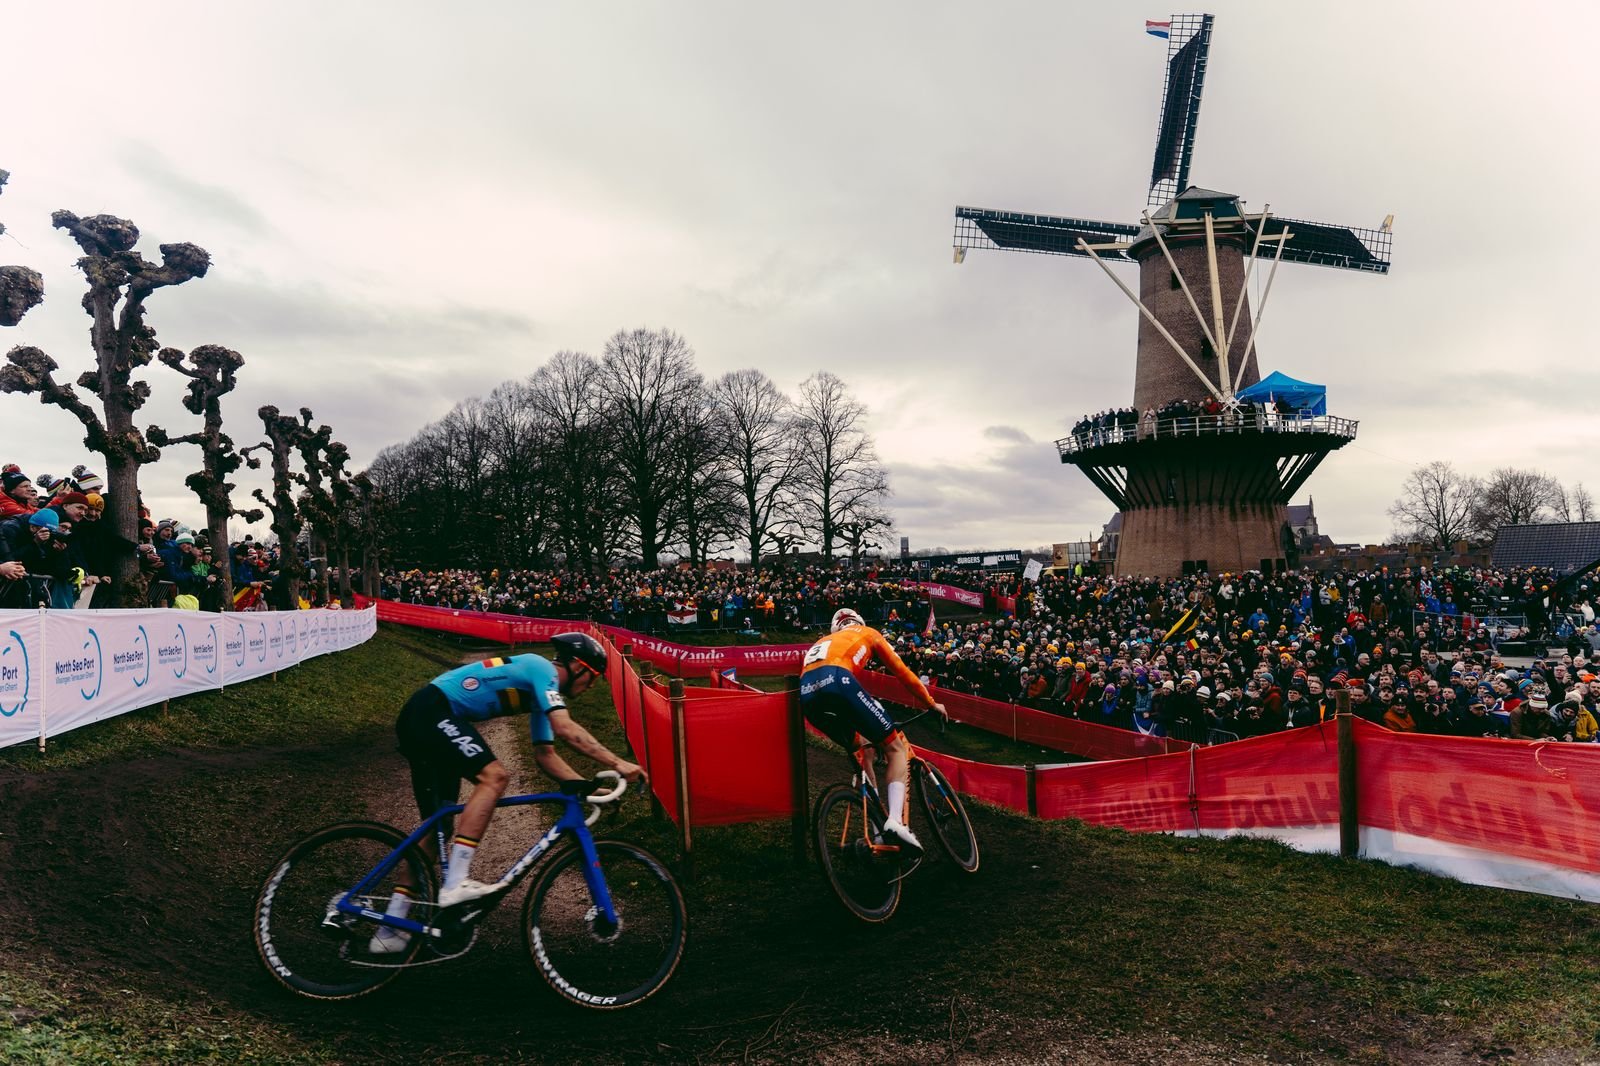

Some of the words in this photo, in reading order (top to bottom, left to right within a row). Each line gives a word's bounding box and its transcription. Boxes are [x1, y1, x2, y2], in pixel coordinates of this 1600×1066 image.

[957, 556, 980, 564] BURGERS
[1005, 553, 1020, 561] WALL
[113, 652, 126, 664] North
[126, 651, 135, 662] Sea
[135, 650, 143, 661] Port
[632, 638, 724, 663] waterzande
[809, 646, 821, 657] 3
[2, 666, 18, 680] Port
[55, 660, 71, 675] North
[72, 659, 82, 672] Sea
[83, 658, 94, 670] Port
[857, 690, 892, 731] Staatsloterij
[502, 825, 561, 883] REK
